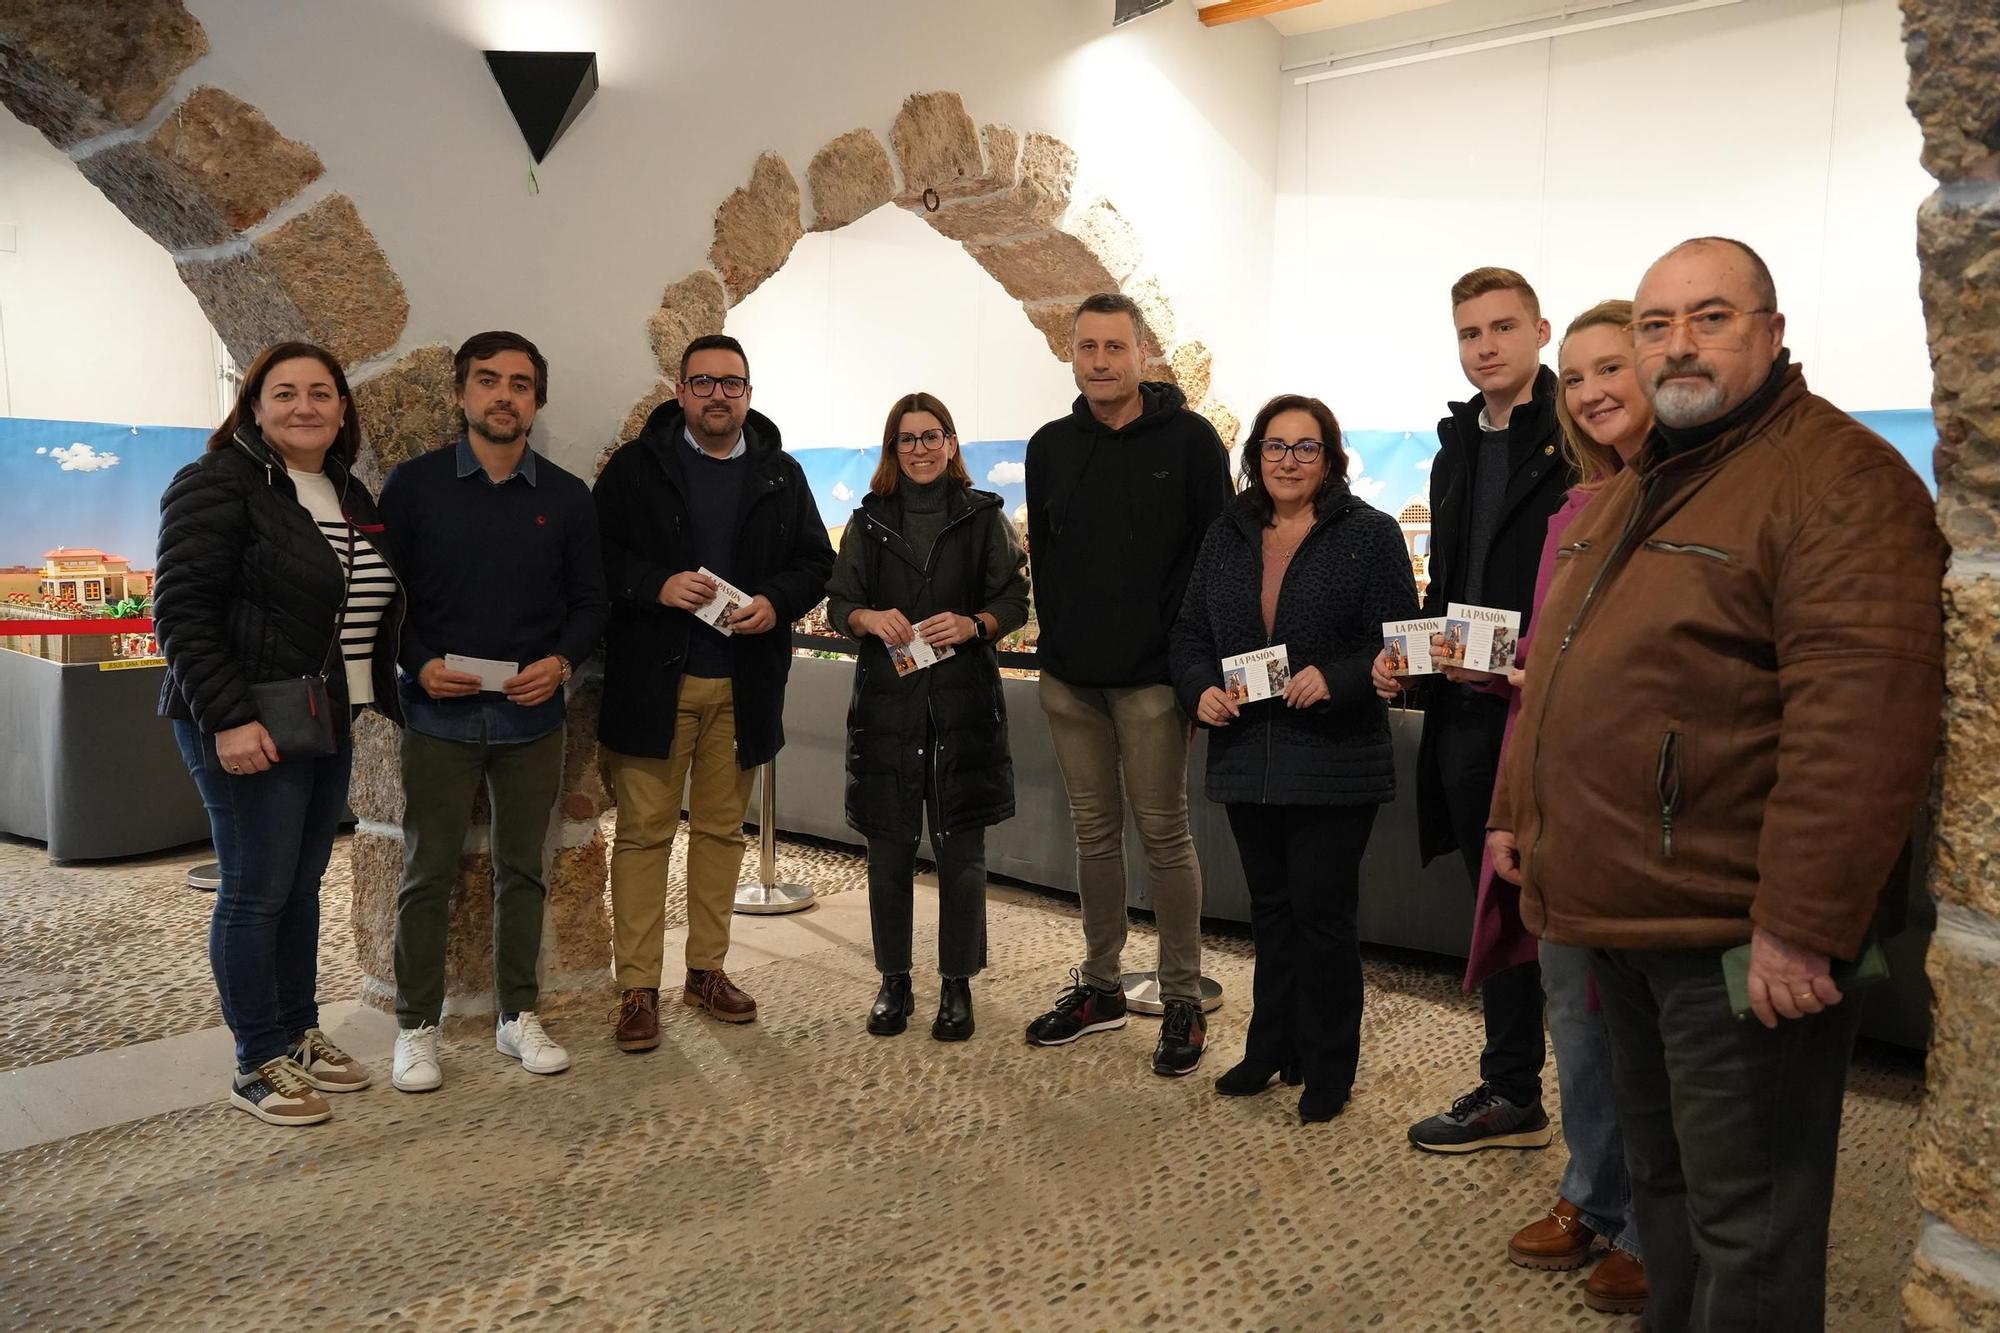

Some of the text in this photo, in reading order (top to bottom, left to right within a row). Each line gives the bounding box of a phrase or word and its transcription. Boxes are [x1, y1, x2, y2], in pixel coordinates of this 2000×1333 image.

[1461, 608, 1507, 624] LA PASIÓN
[1395, 619, 1439, 633] LA PASIÓN
[1234, 657, 1244, 667] LA
